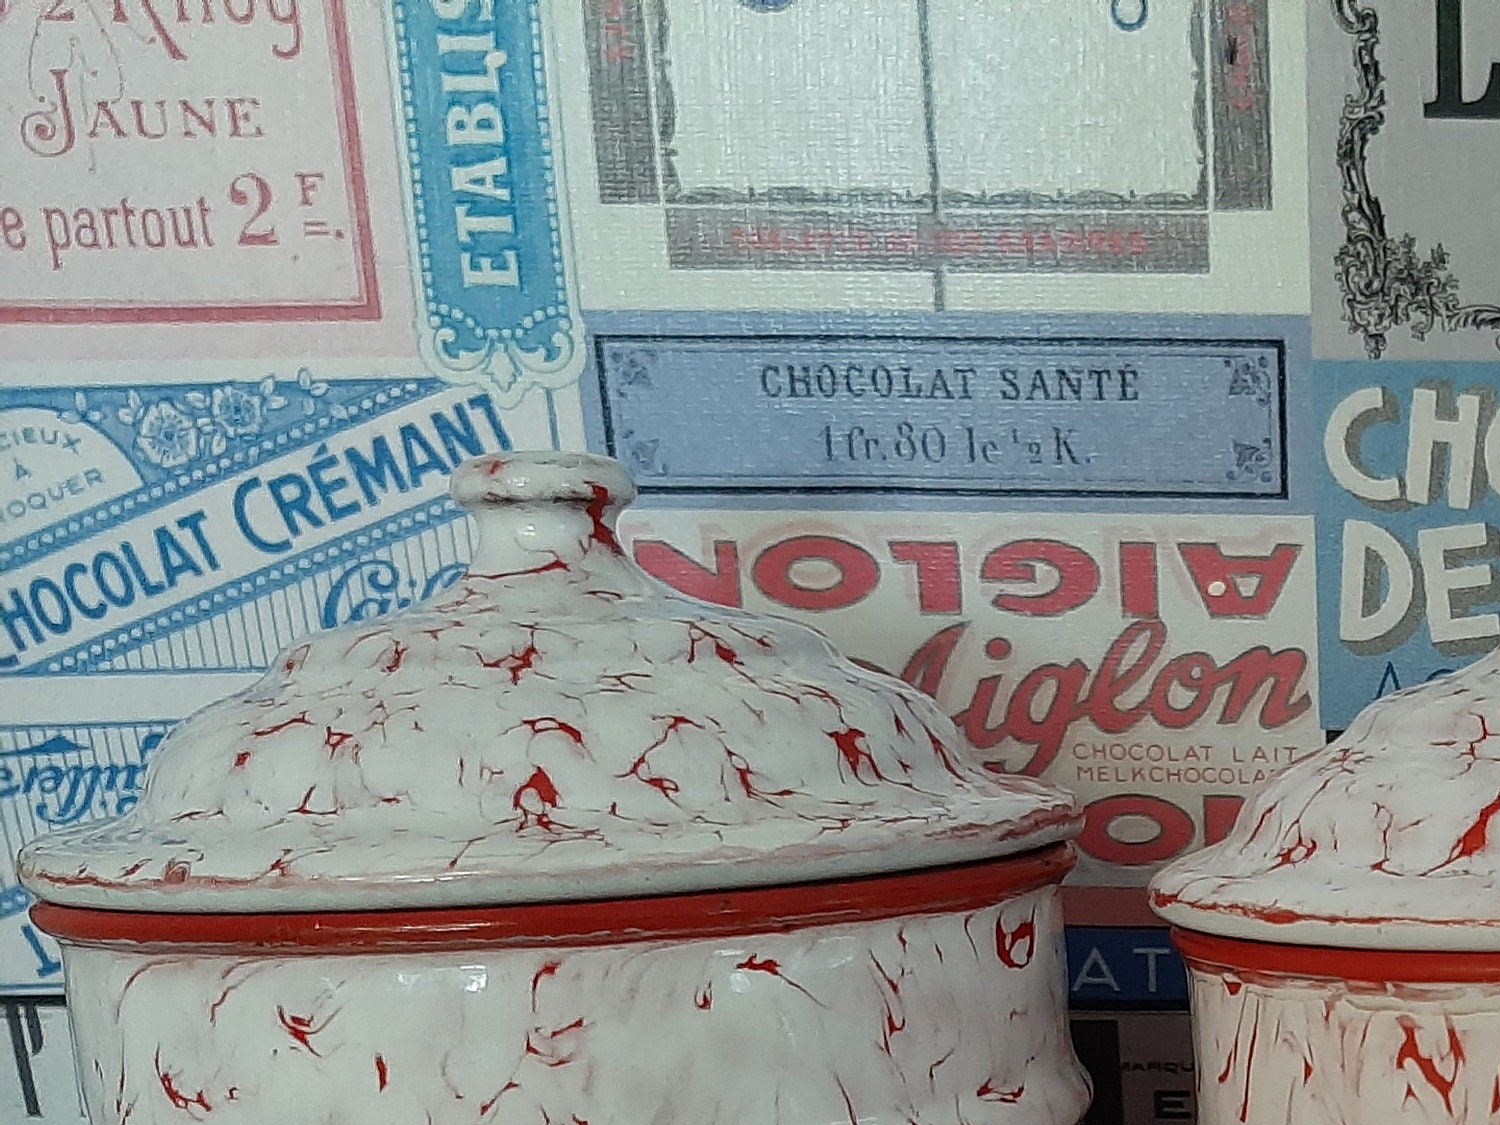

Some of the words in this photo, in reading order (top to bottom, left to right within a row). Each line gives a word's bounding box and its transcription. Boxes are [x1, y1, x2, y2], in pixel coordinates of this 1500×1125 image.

[43, 198, 216, 270] partout
[229, 172, 280, 246] 2
[760, 364, 977, 399] CHOCOLAT
[1000, 363, 1140, 401] SANTÉ
[0, 508, 221, 669] HOCOLAT
[232, 390, 516, 556] CRÉMANT
[1072, 743, 1213, 763] CHOCOLAT
[1232, 745, 1299, 765] LAIT
